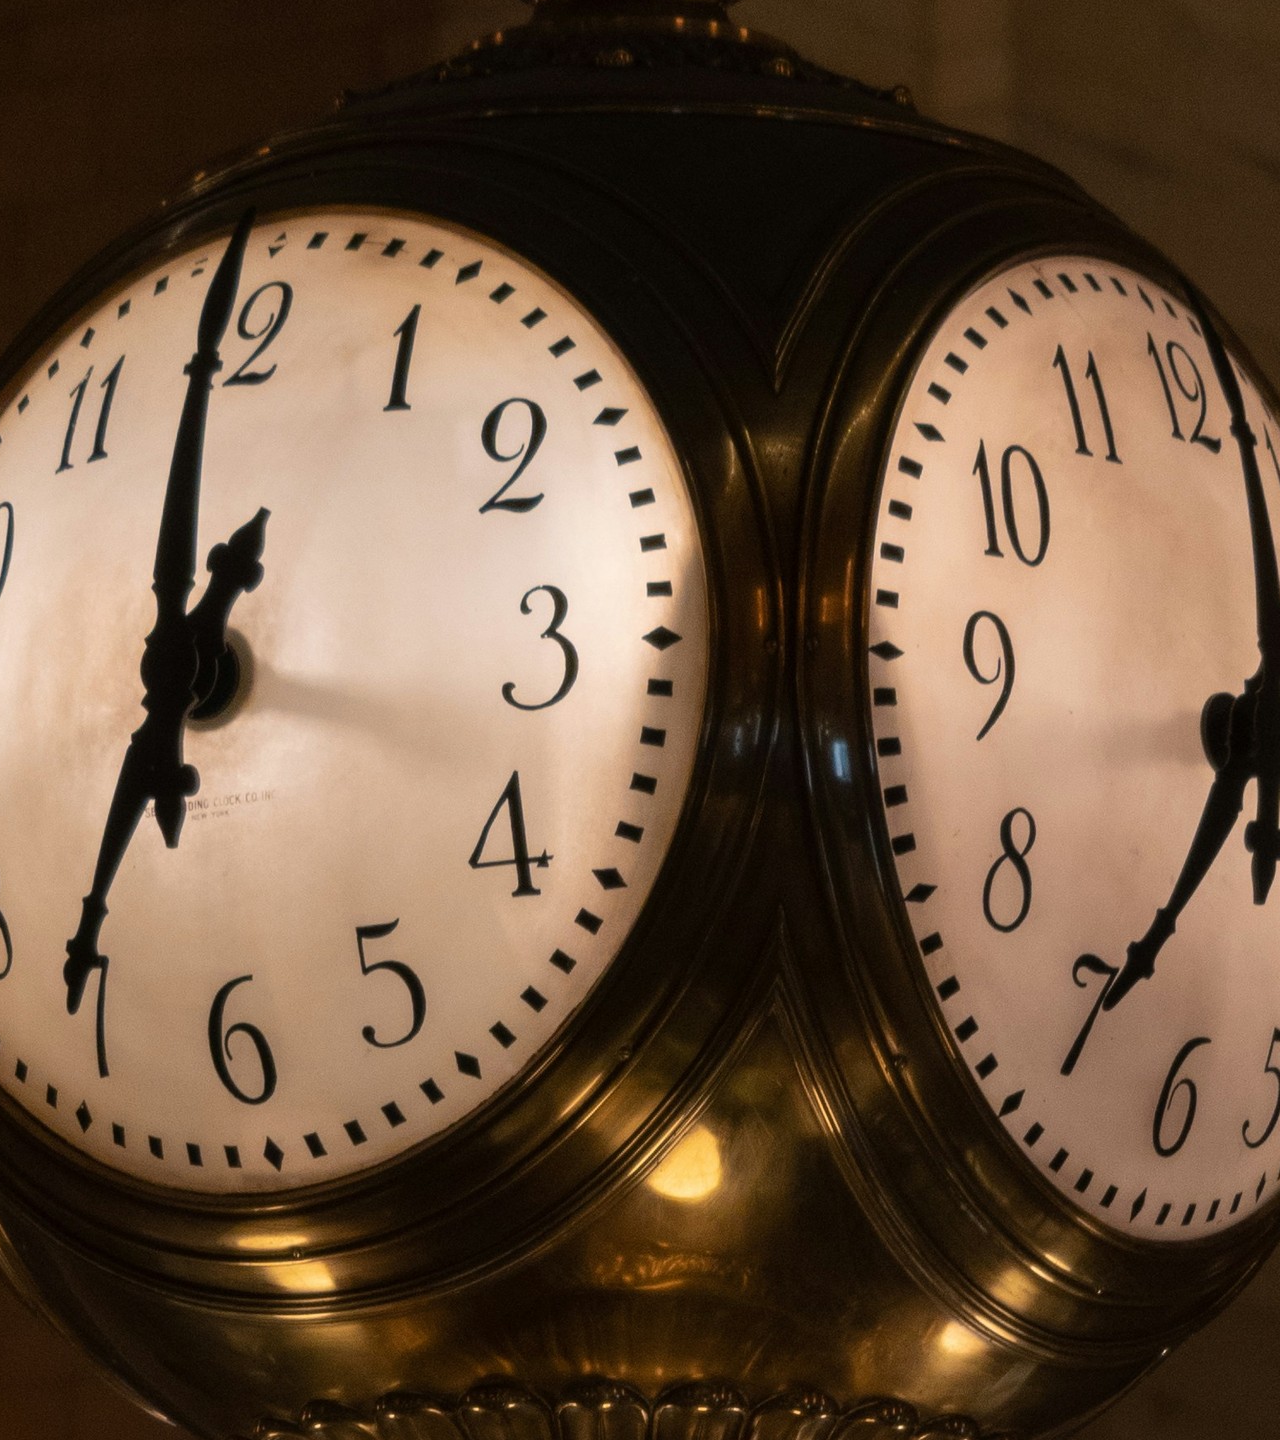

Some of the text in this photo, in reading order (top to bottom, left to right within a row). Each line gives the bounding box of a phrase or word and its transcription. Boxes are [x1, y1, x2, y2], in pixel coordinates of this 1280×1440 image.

[55, 354, 126, 474] 11
[382, 303, 421, 413] 1
[1052, 343, 1123, 465] 11
[1145, 330, 1222, 456] 12
[478, 397, 548, 515] 2
[973, 437, 1051, 568] 10
[500, 584, 579, 710] 3
[962, 610, 1016, 743] 9
[467, 770, 554, 898] 4
[981, 807, 1037, 933] 8
[206, 974, 278, 1105] 6
[354, 917, 427, 1049] 5
[1060, 952, 1121, 1077] 7
[1151, 1036, 1211, 1159] 6
